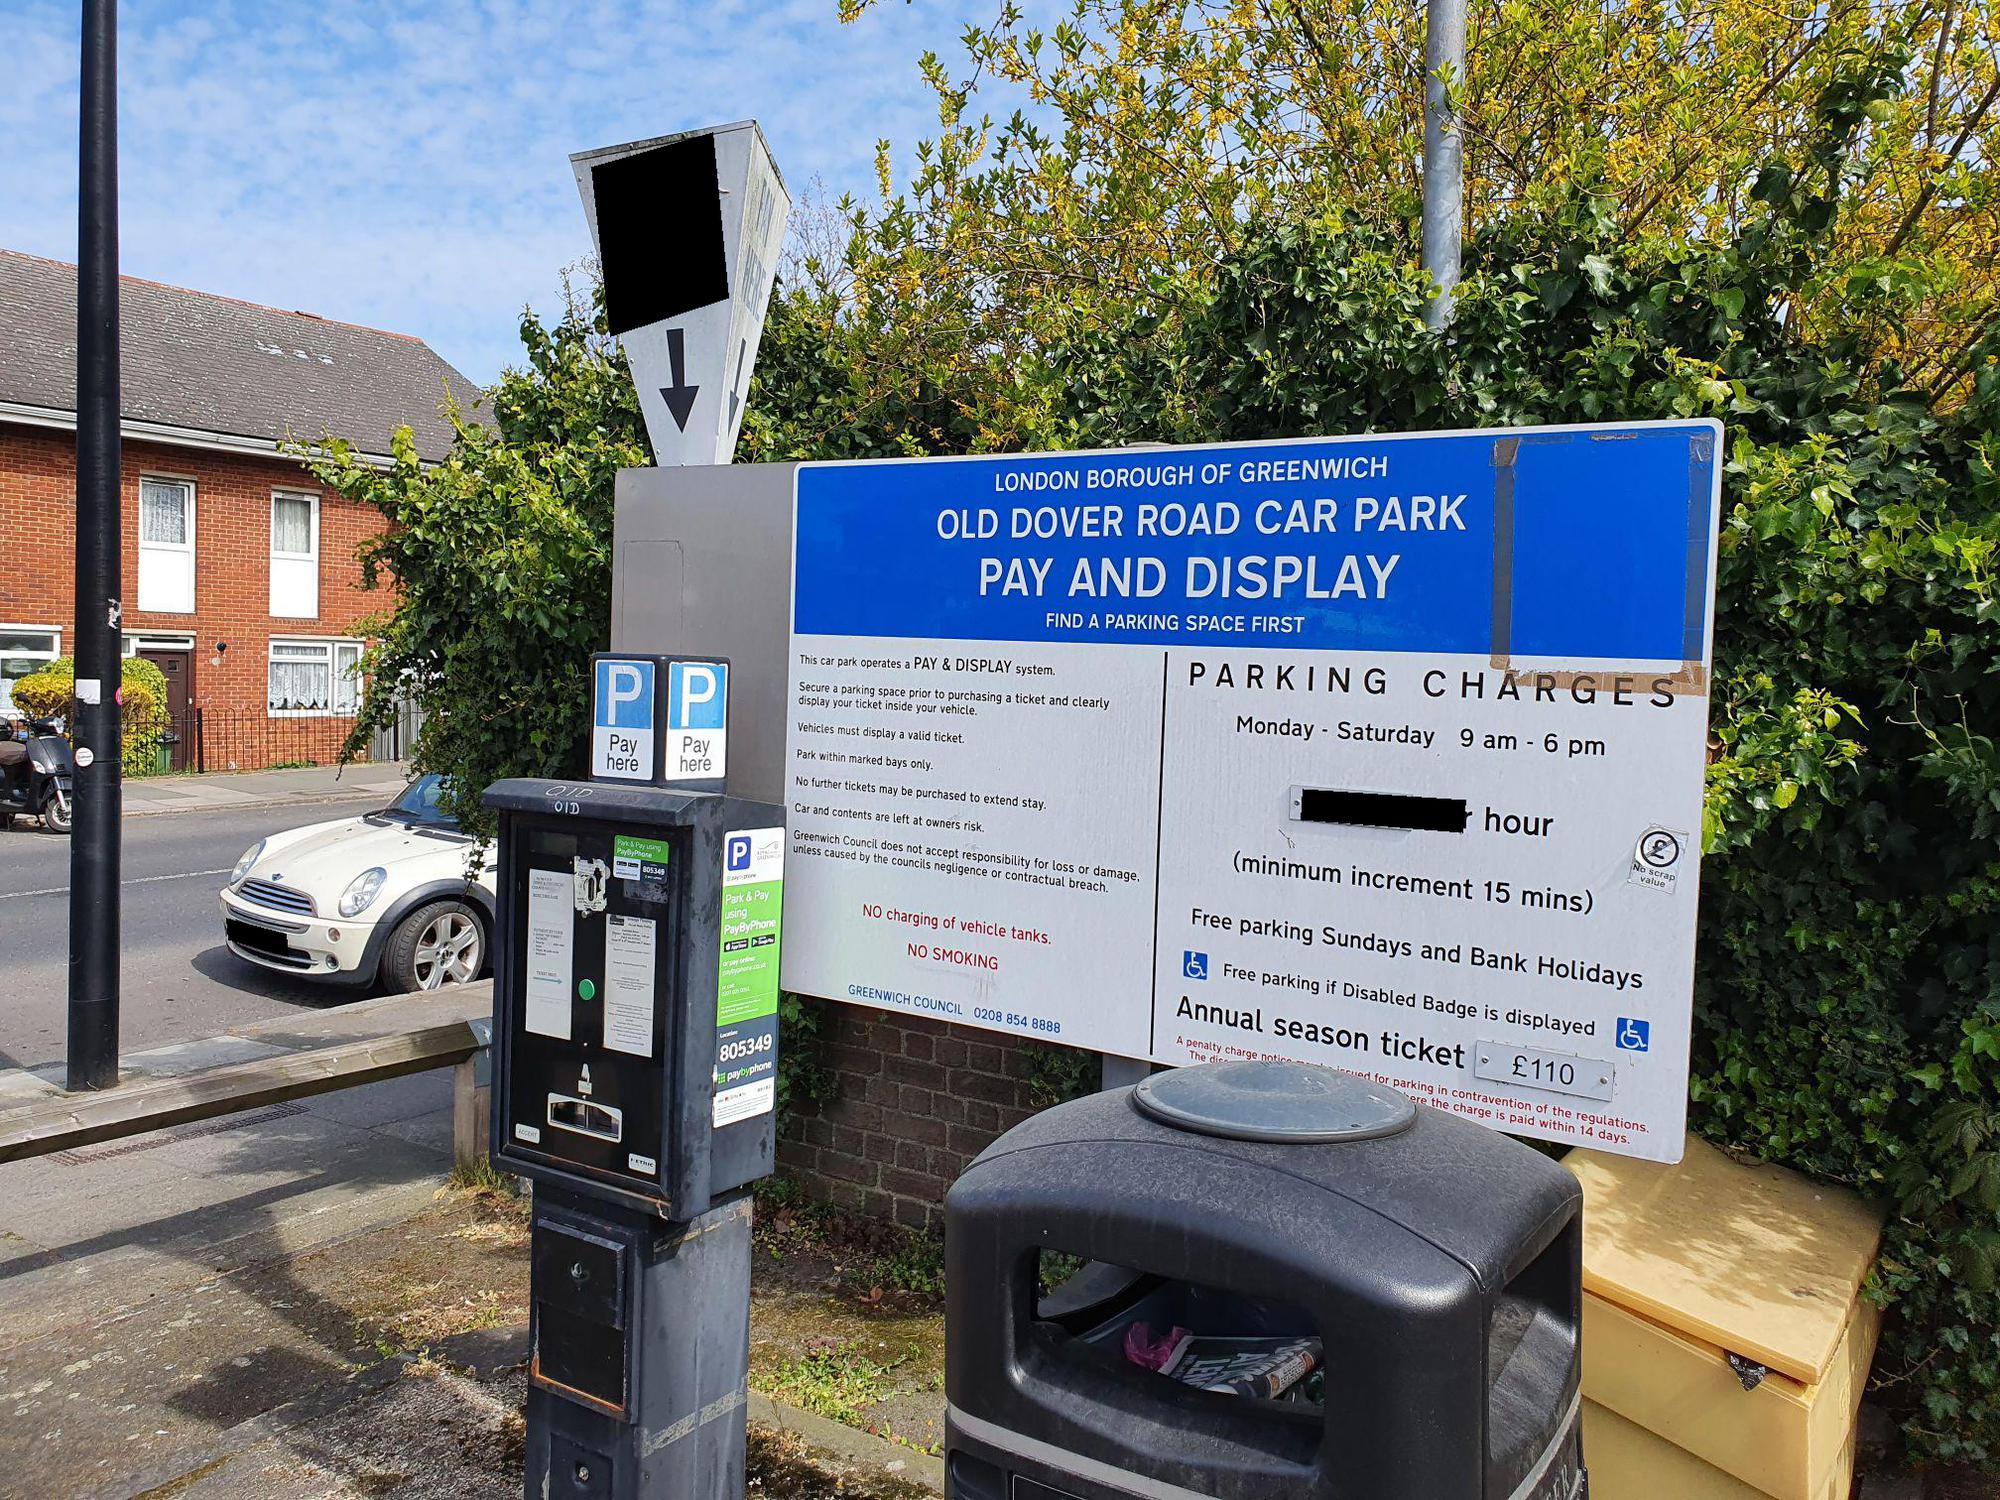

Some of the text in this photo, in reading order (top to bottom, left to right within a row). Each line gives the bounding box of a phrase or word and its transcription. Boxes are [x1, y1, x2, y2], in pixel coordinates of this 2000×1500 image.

[995, 455, 1389, 492] LONDON BOROUGH OF GREENWICH
[936, 494, 1468, 540] OLD DOVER ROAD CAR PARK
[979, 555, 1400, 599] PAY AND DISPLAY
[1046, 613, 1305, 633] FIND A PARKING SPACE FIRST
[800, 655, 1056, 676] This car park operates PAY & DISPLAY system.
[607, 664, 643, 725] P
[681, 666, 717, 727] P
[1189, 662, 1677, 709] PARKING CHARGES
[798, 696, 978, 716] display your ticket inside your vehicle.
[610, 733, 638, 752] Pay
[683, 735, 710, 754] Pay
[798, 722, 964, 744] Vehicles must display valid ticket.
[1236, 715, 1606, 757] Monday Saturday 9 am 6 pm
[607, 753, 639, 772] here
[680, 753, 712, 772] here
[797, 749, 933, 771] Park within marked bays only.
[796, 776, 1047, 811] No further tickets may be purchased to extend stay.
[795, 803, 985, 833] Car and contents are left at owners risk.
[1485, 805, 1554, 837] hour
[732, 841, 748, 867] P
[793, 830, 1140, 882] Greenwich Council does not accept responsibility for loss or damage,
[642, 866, 665, 876] 805349
[1233, 850, 1593, 915] (minimum increment 15 mins)
[1633, 863, 1676, 882] No scrap
[1640, 876, 1666, 888] value
[725, 890, 769, 905] Park & Pay
[724, 919, 776, 936] PayByPhone
[725, 909, 748, 921] using
[863, 904, 1051, 945] NO charging of vehicle tanks.
[907, 943, 999, 970] NO SMOKING
[1191, 908, 1643, 991] Free parking Sundays and Bank Holidays
[848, 984, 1061, 1034] GREENWICH COUNCIL 0208 854 8888
[1224, 963, 1595, 1036] Free parking if Disabled Badge is displayed
[719, 1033, 773, 1062] 805349
[1176, 995, 1574, 1085] Annual season ticket £110
[1189, 1051, 1206, 1062] The
[727, 1061, 772, 1082] paybyphone
[1176, 1035, 1183, 1045] A
[1186, 1038, 1222, 1054] penalty
[1225, 1045, 1257, 1060] charge
[1374, 1072, 1389, 1085] for
[1393, 1078, 1434, 1095] parking
[1437, 1085, 1448, 1095] in
[1452, 1088, 1532, 1111] contravention
[1536, 1103, 1548, 1114] of
[1552, 1106, 1571, 1119] the
[1576, 1112, 1649, 1134] regulations.
[1431, 1097, 1630, 1145] the charge is paid within 14 days.
